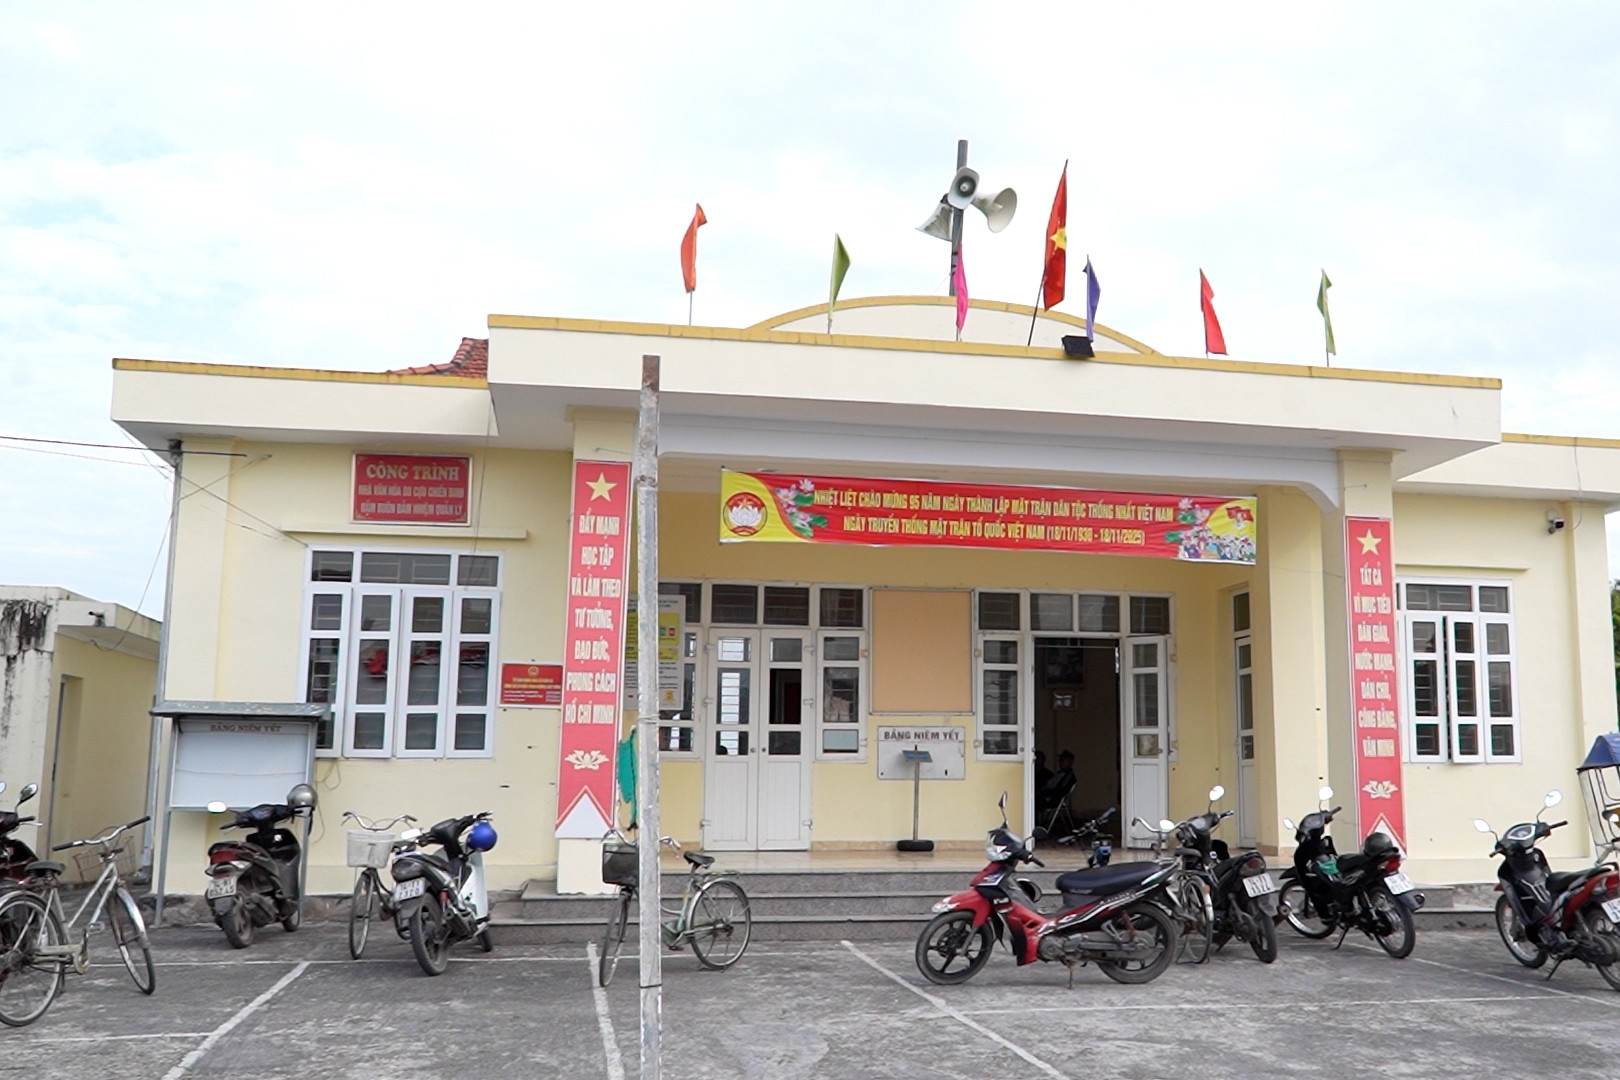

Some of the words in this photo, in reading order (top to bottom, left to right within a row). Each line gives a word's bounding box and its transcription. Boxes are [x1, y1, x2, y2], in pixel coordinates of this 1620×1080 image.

[366, 461, 409, 480] CÔNG
[412, 462, 460, 481] TRÌNH
[814, 487, 838, 509] NHIỆT
[840, 488, 857, 511] LIỆT
[859, 489, 881, 508] CHÀO
[921, 491, 941, 511] NĂM
[943, 493, 965, 512] NGÀY
[966, 494, 993, 513] THÀNH
[994, 496, 1010, 517] LẬP
[1011, 497, 1029, 518] MẶT
[1031, 497, 1051, 519] TRẬN
[1071, 500, 1086, 520] TỘC
[1088, 499, 1114, 519] THỐNG
[1115, 500, 1136, 519] NHẤT
[1137, 503, 1154, 524] VIỆT
[1155, 505, 1174, 522] NAM
[843, 513, 866, 532] NGÀY
[867, 513, 900, 533] TRUYỀN
[901, 513, 928, 535] THỐNG
[929, 517, 948, 539] MẶT
[949, 517, 971, 540] TRẬN
[984, 517, 1006, 540] QUỐC
[1007, 520, 1025, 542] VIỆT
[1026, 524, 1045, 540] NAM
[599, 543, 615, 570] TẬP
[571, 573, 582, 596] VÀ
[583, 573, 600, 597] LÀM
[601, 578, 621, 598] THEO
[594, 668, 616, 692] CÁCH
[884, 729, 911, 740] BẢNG
[914, 730, 939, 740] NIÊM
[943, 729, 960, 740] YẾT
